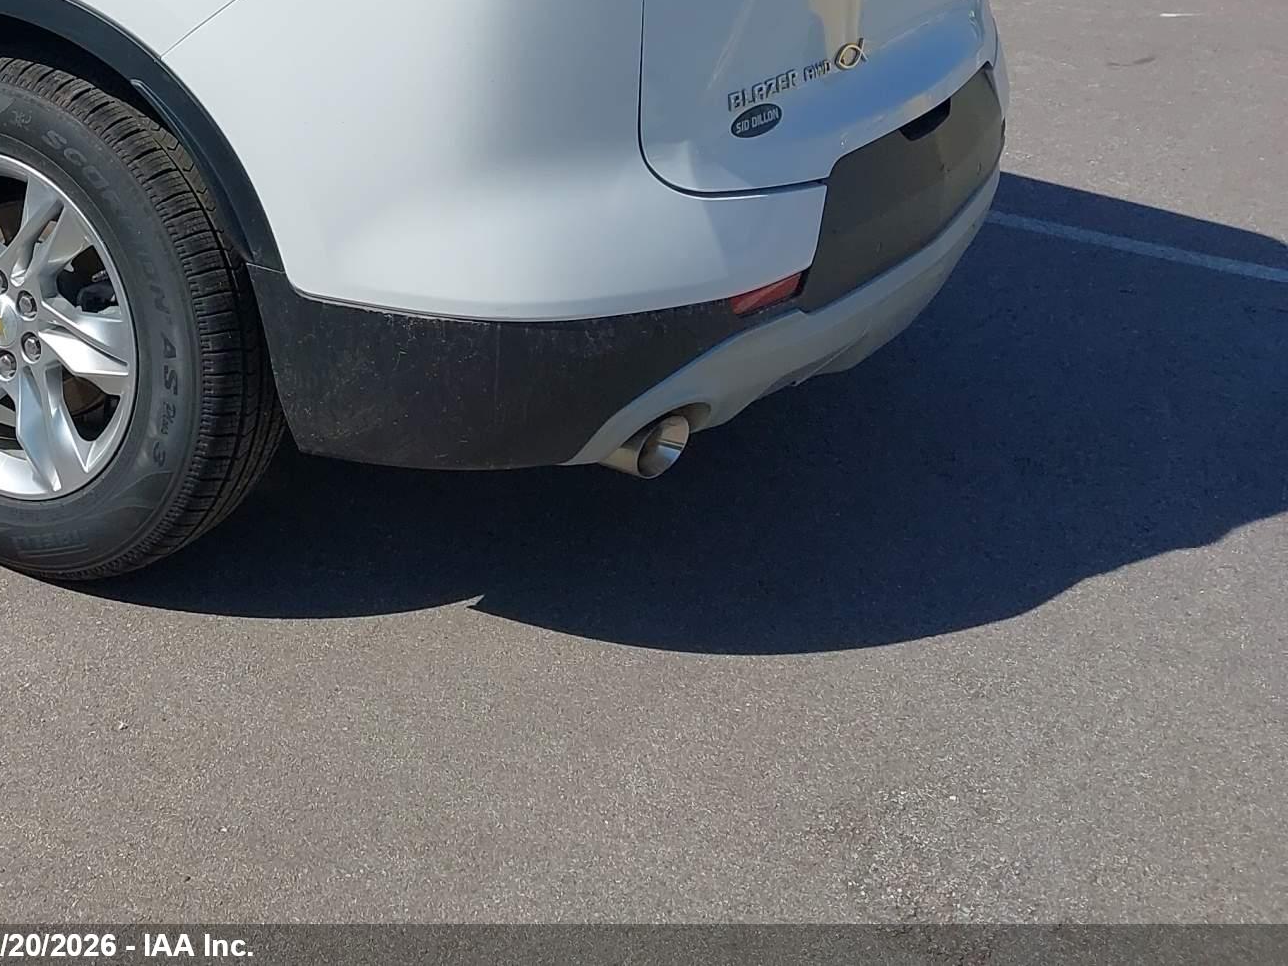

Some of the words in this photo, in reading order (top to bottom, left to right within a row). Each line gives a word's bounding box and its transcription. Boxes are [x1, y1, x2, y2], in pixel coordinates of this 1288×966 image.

[728, 69, 799, 111] BLAZER
[804, 59, 832, 82] AWD
[736, 118, 751, 134] SID
[751, 108, 780, 129] DILLON
[160, 332, 179, 396] AS
[153, 441, 166, 467] 3
